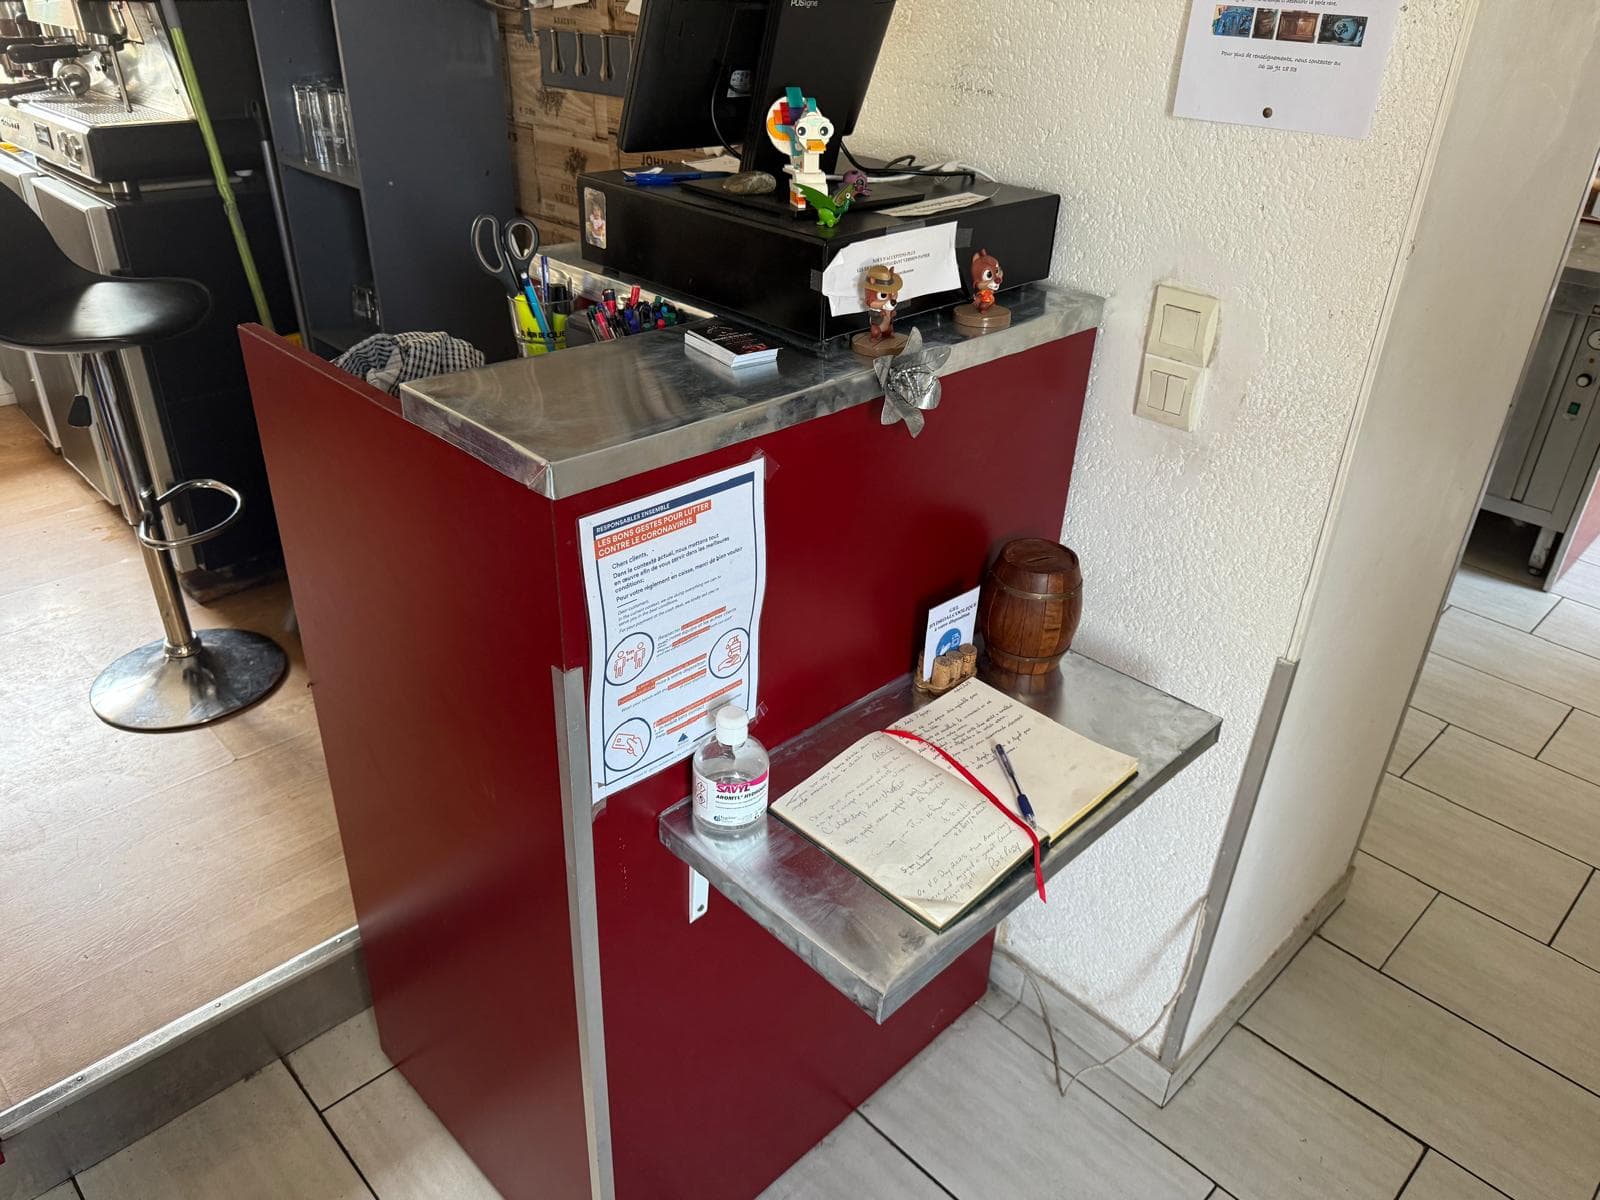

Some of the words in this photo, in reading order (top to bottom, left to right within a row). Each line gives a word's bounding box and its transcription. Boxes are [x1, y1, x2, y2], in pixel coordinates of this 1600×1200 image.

[596, 514, 640, 532] RESPONSABLES
[641, 503, 671, 517] ENSEMBLE
[597, 536, 611, 548] LES
[612, 529, 634, 543] BONS
[635, 518, 662, 534] GESTES
[663, 512, 683, 524] POUR
[684, 502, 710, 516] LUTTER
[599, 539, 630, 557] CONTRE
[631, 537, 640, 545] LE
[641, 517, 693, 541] CORONAVIRUS
[611, 560, 628, 569] Chers
[629, 552, 649, 563] clients,
[612, 570, 627, 579] Dans
[633, 558, 657, 571] contexte
[687, 537, 708, 549] mettons
[708, 533, 719, 541] tout
[640, 568, 650, 576] afin
[658, 560, 671, 569] vous
[671, 552, 686, 563] servir
[685, 549, 698, 557] dans
[616, 594, 629, 603] Pour
[629, 588, 644, 597] votre
[694, 560, 709, 570] merci
[715, 553, 727, 562] bien
[715, 783, 751, 793] SAVYL
